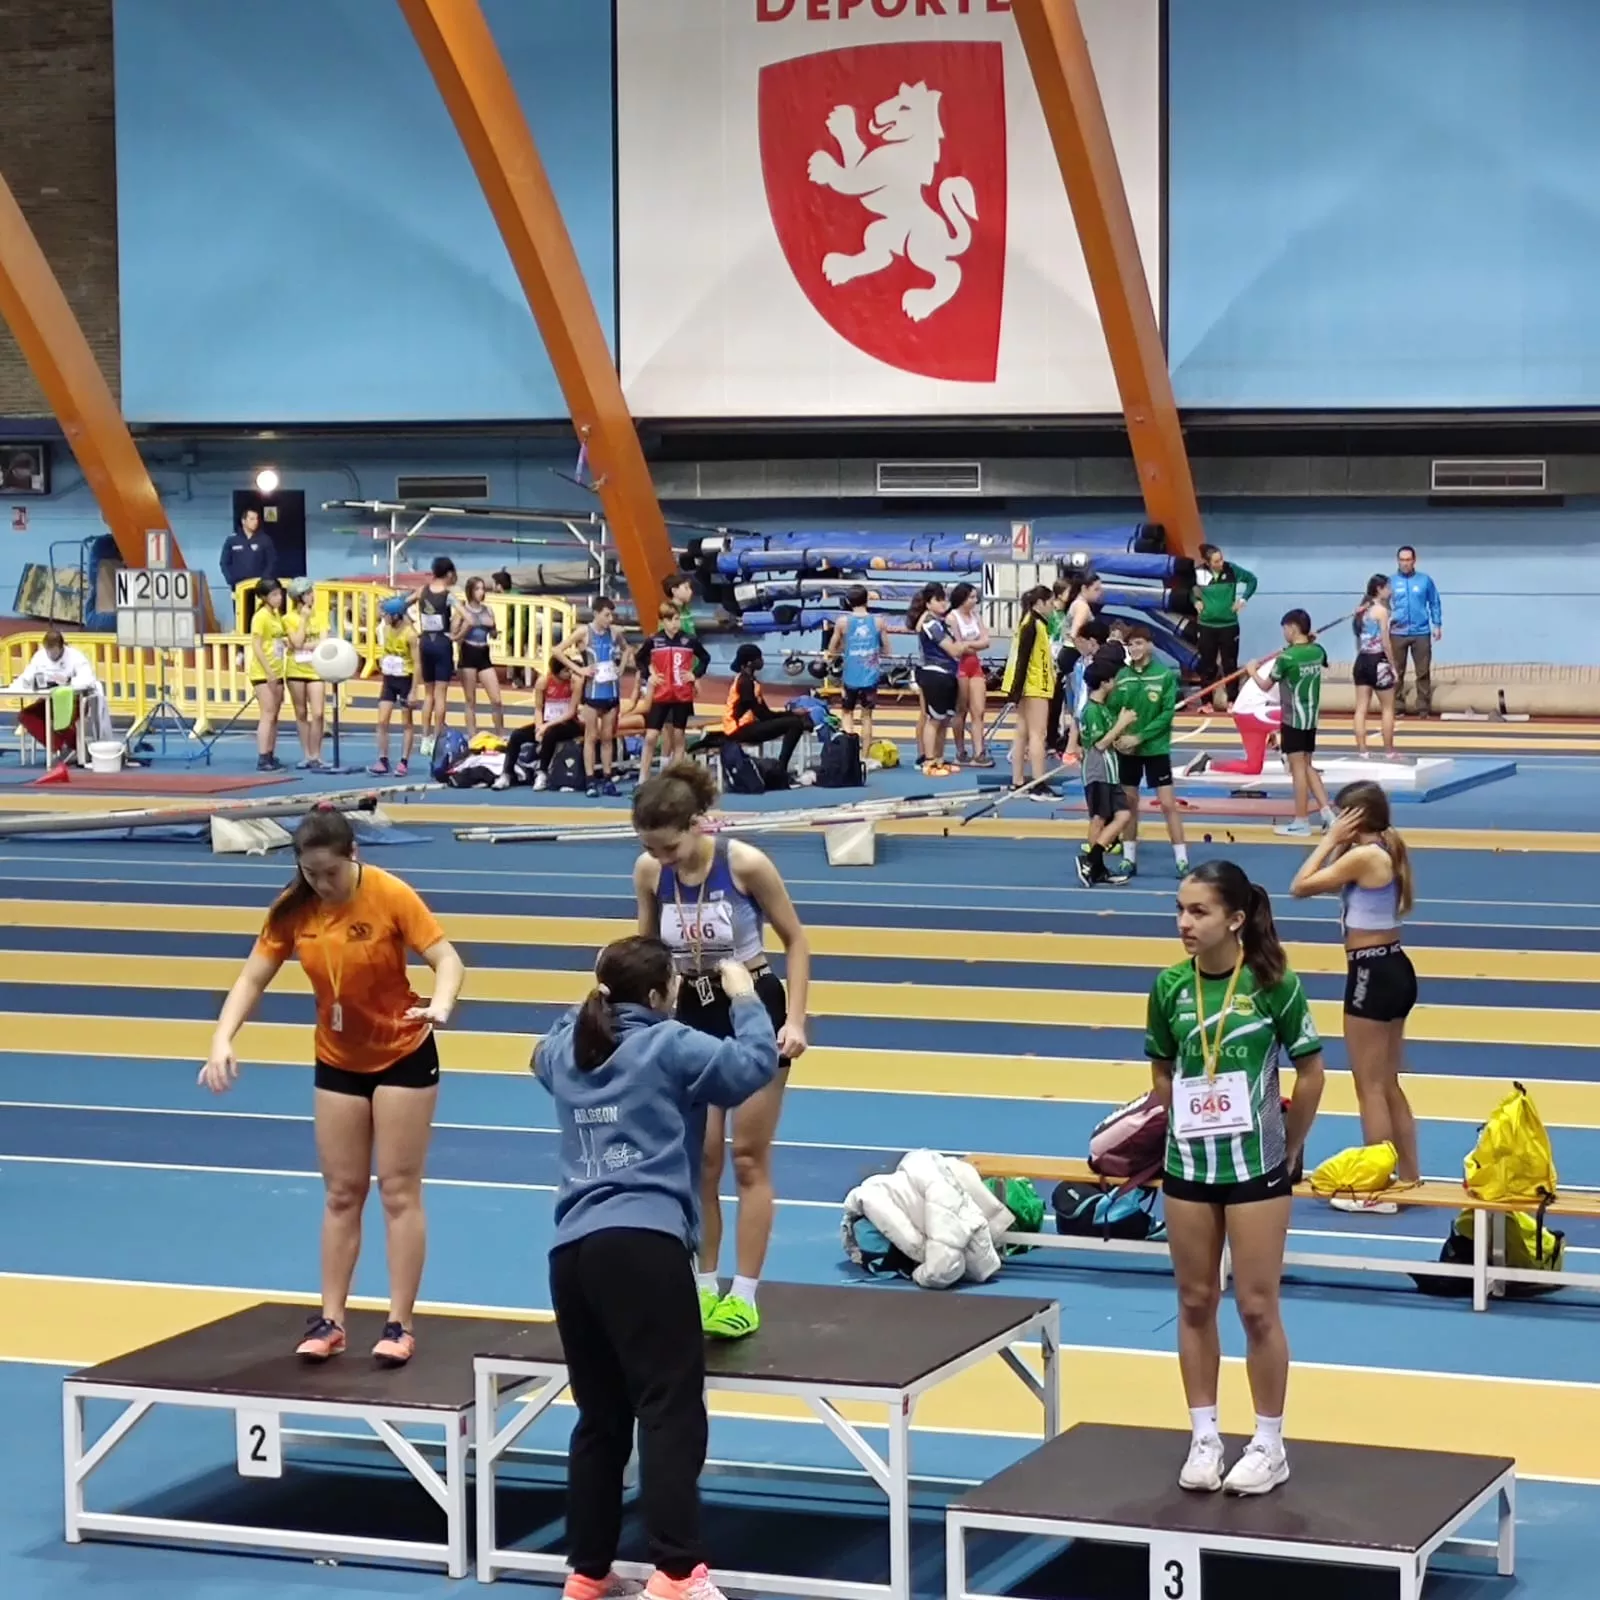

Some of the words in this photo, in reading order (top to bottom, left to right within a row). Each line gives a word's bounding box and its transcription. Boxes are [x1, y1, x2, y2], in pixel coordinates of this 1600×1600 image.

[151, 534, 162, 561] 1
[1014, 524, 1028, 552] 4
[984, 563, 995, 596] N
[1356, 946, 1388, 960] PRO
[1189, 1094, 1231, 1115] 646
[249, 1424, 268, 1462] 2
[1164, 1559, 1184, 1600] 3
